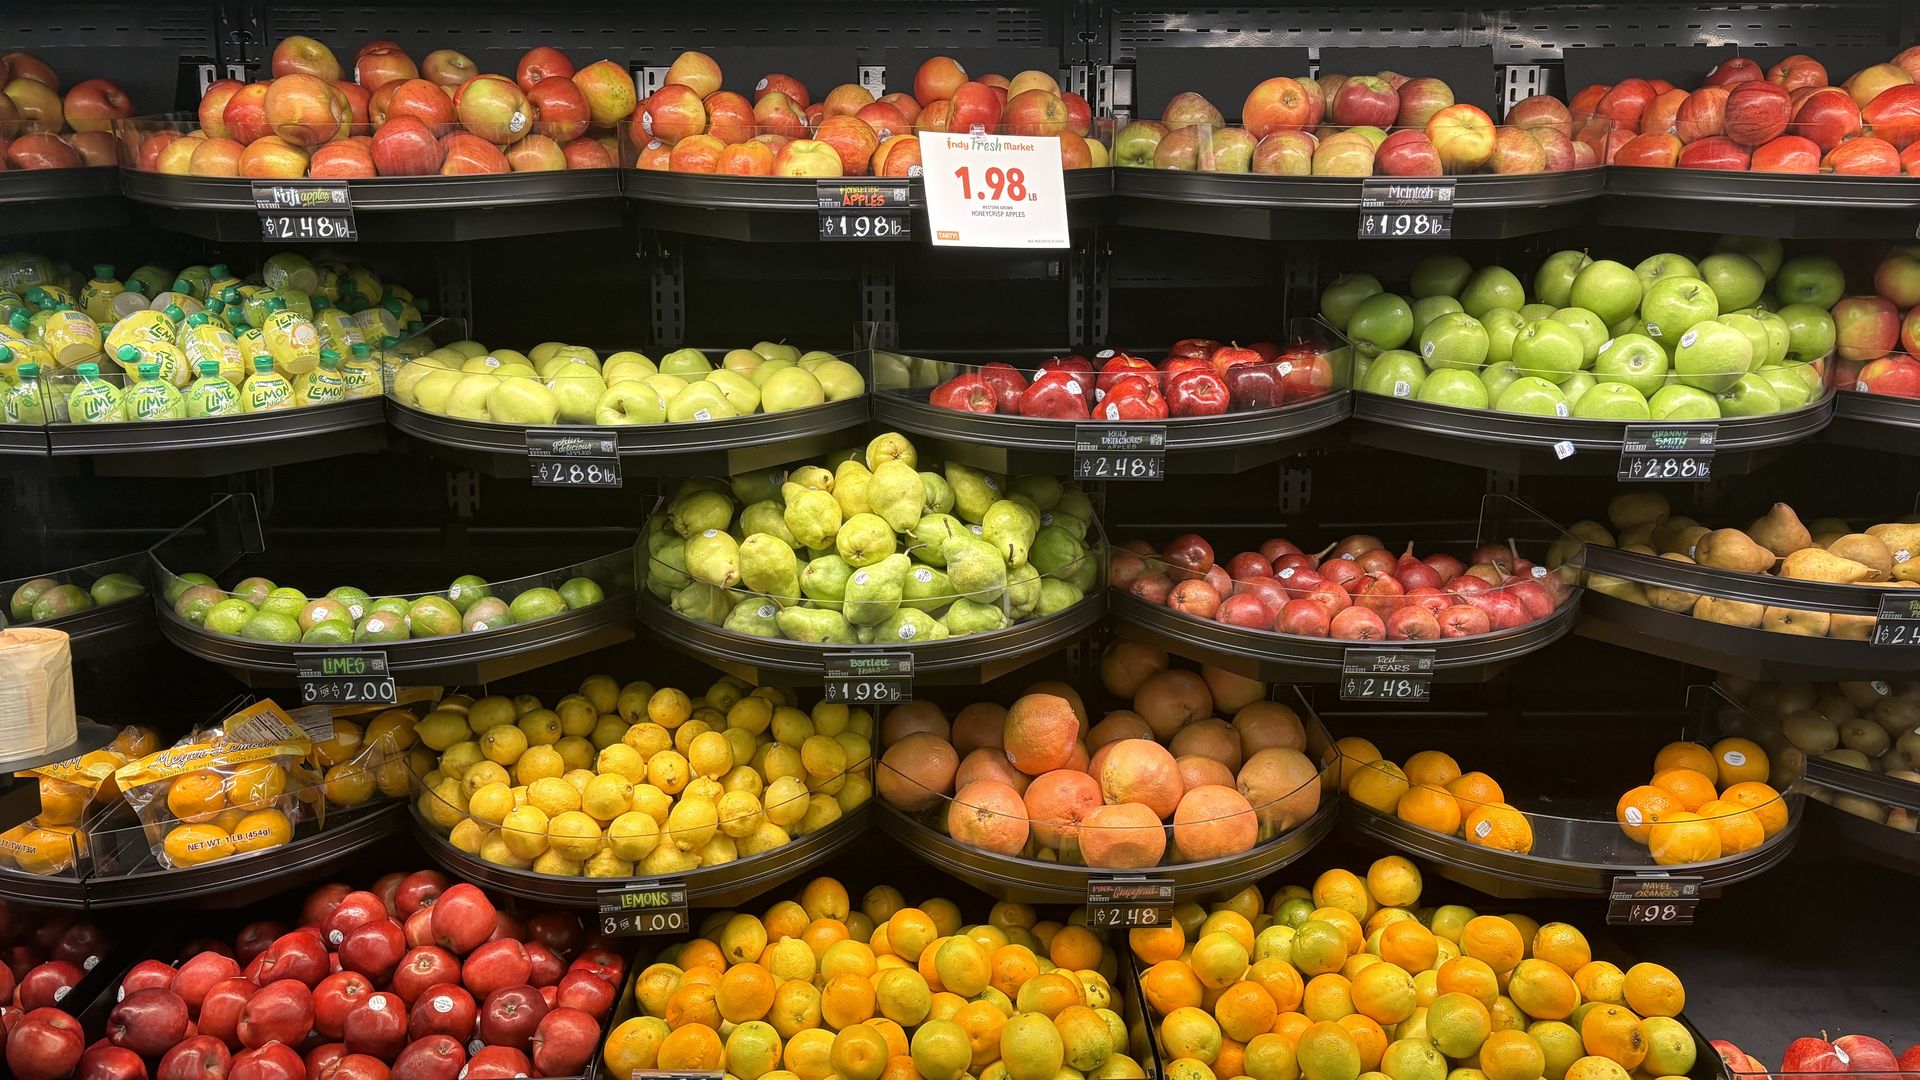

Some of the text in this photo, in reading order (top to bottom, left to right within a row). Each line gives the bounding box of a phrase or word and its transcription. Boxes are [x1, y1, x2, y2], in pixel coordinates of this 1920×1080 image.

[954, 166, 1038, 201] 1.98 LB
[841, 194, 886, 207] APPLES
[149, 323, 176, 345] LEMO
[136, 391, 170, 417] LIME
[205, 387, 235, 412] LIME
[252, 382, 290, 408] LEMON
[84, 391, 116, 419] LIME
[1101, 436, 1143, 445] DELICIOUS
[849, 658, 890, 668] Bartlett
[1372, 664, 1410, 672] PEARS
[1374, 655, 1403, 665] Red
[304, 682, 318, 701] 3
[147, 750, 206, 769] Meyer
[187, 842, 205, 851] NET
[232, 833, 243, 842] LB
[245, 827, 271, 840] (454g)
[1634, 889, 1680, 898] ORANGES
[1641, 882, 1673, 890] NAVEL
[621, 891, 670, 908] LEMONS
[604, 917, 618, 934] 3
[634, 912, 682, 932] 1.00
